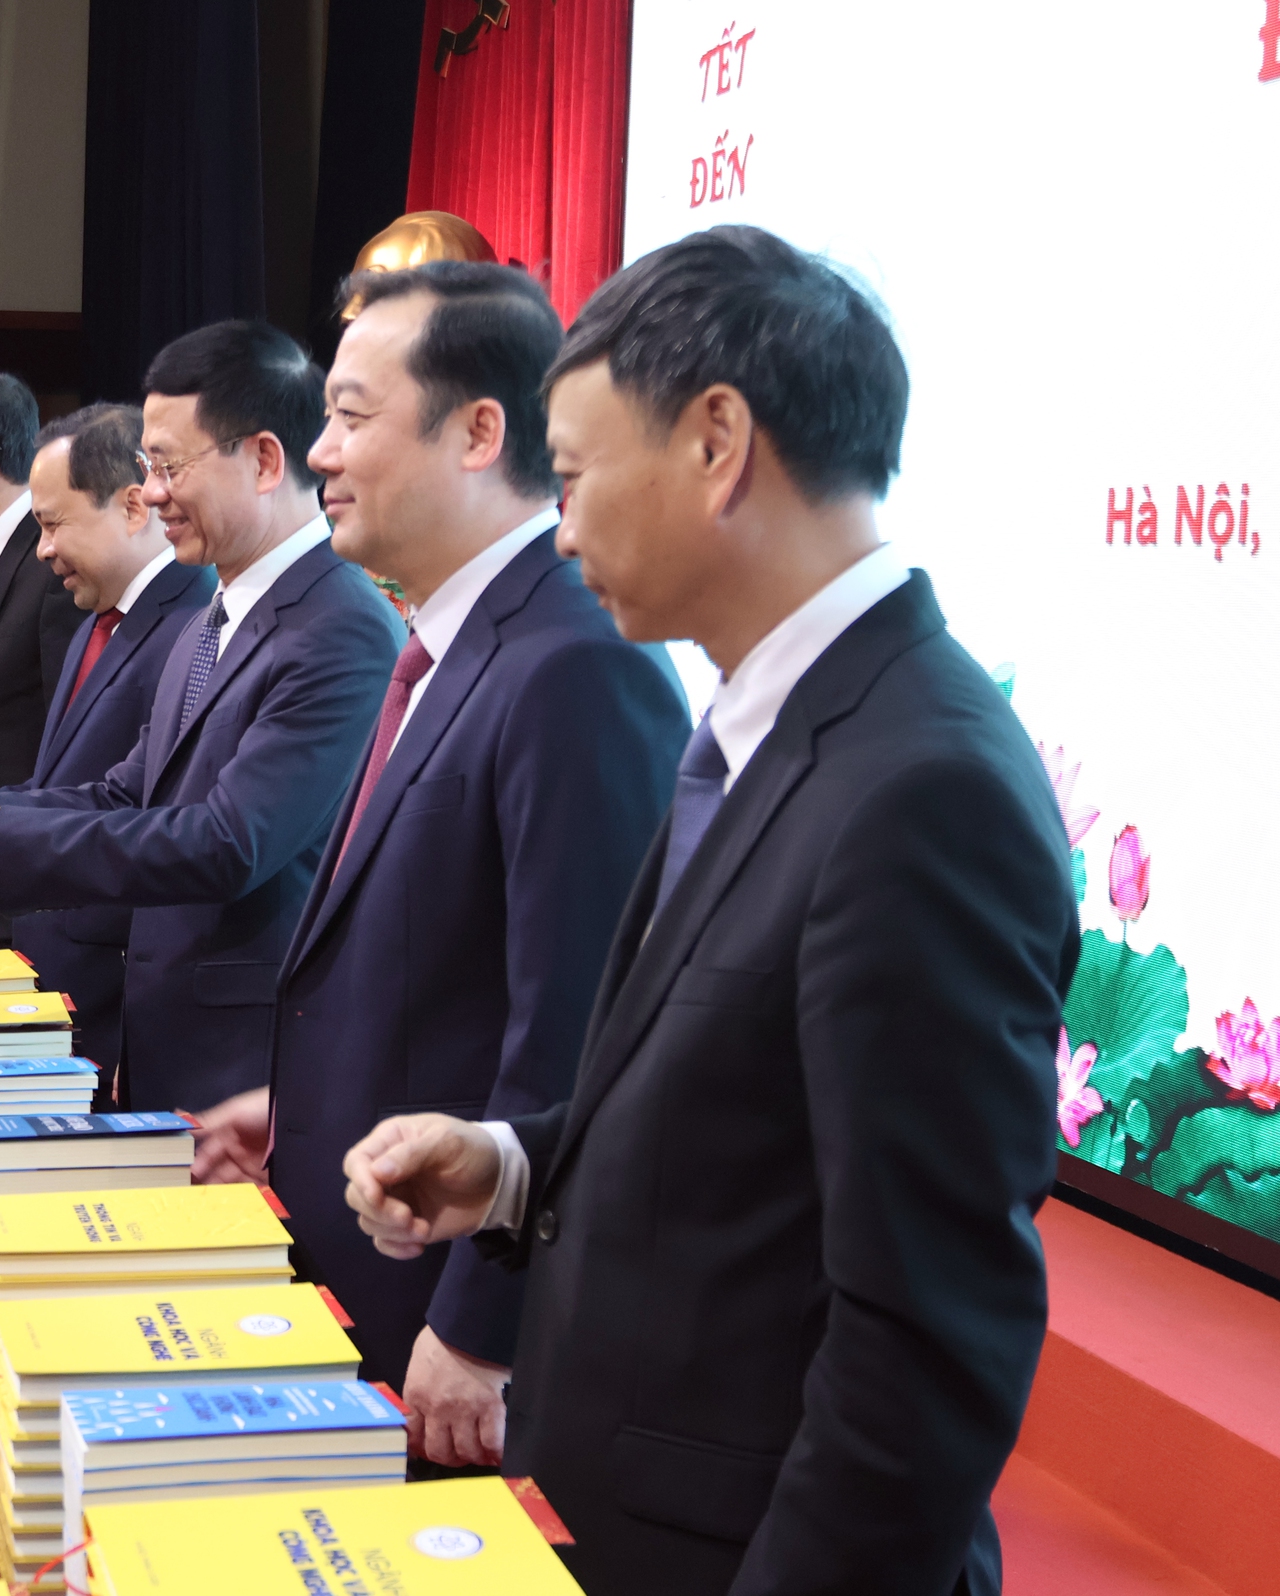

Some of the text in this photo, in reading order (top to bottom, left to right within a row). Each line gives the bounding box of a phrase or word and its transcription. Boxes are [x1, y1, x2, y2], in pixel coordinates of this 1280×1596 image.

[699, 20, 756, 103] TẾT
[689, 128, 754, 209] ĐẾN
[1105, 482, 1260, 562] Hà Nội,
[136, 1317, 160, 1337] CÔNG
[156, 1302, 182, 1327] KHOA
[169, 1329, 193, 1345] HỌC
[279, 1530, 334, 1596] CÔNG NGH
[302, 1508, 339, 1546] KHOA
[325, 1549, 358, 1575] HỌC
